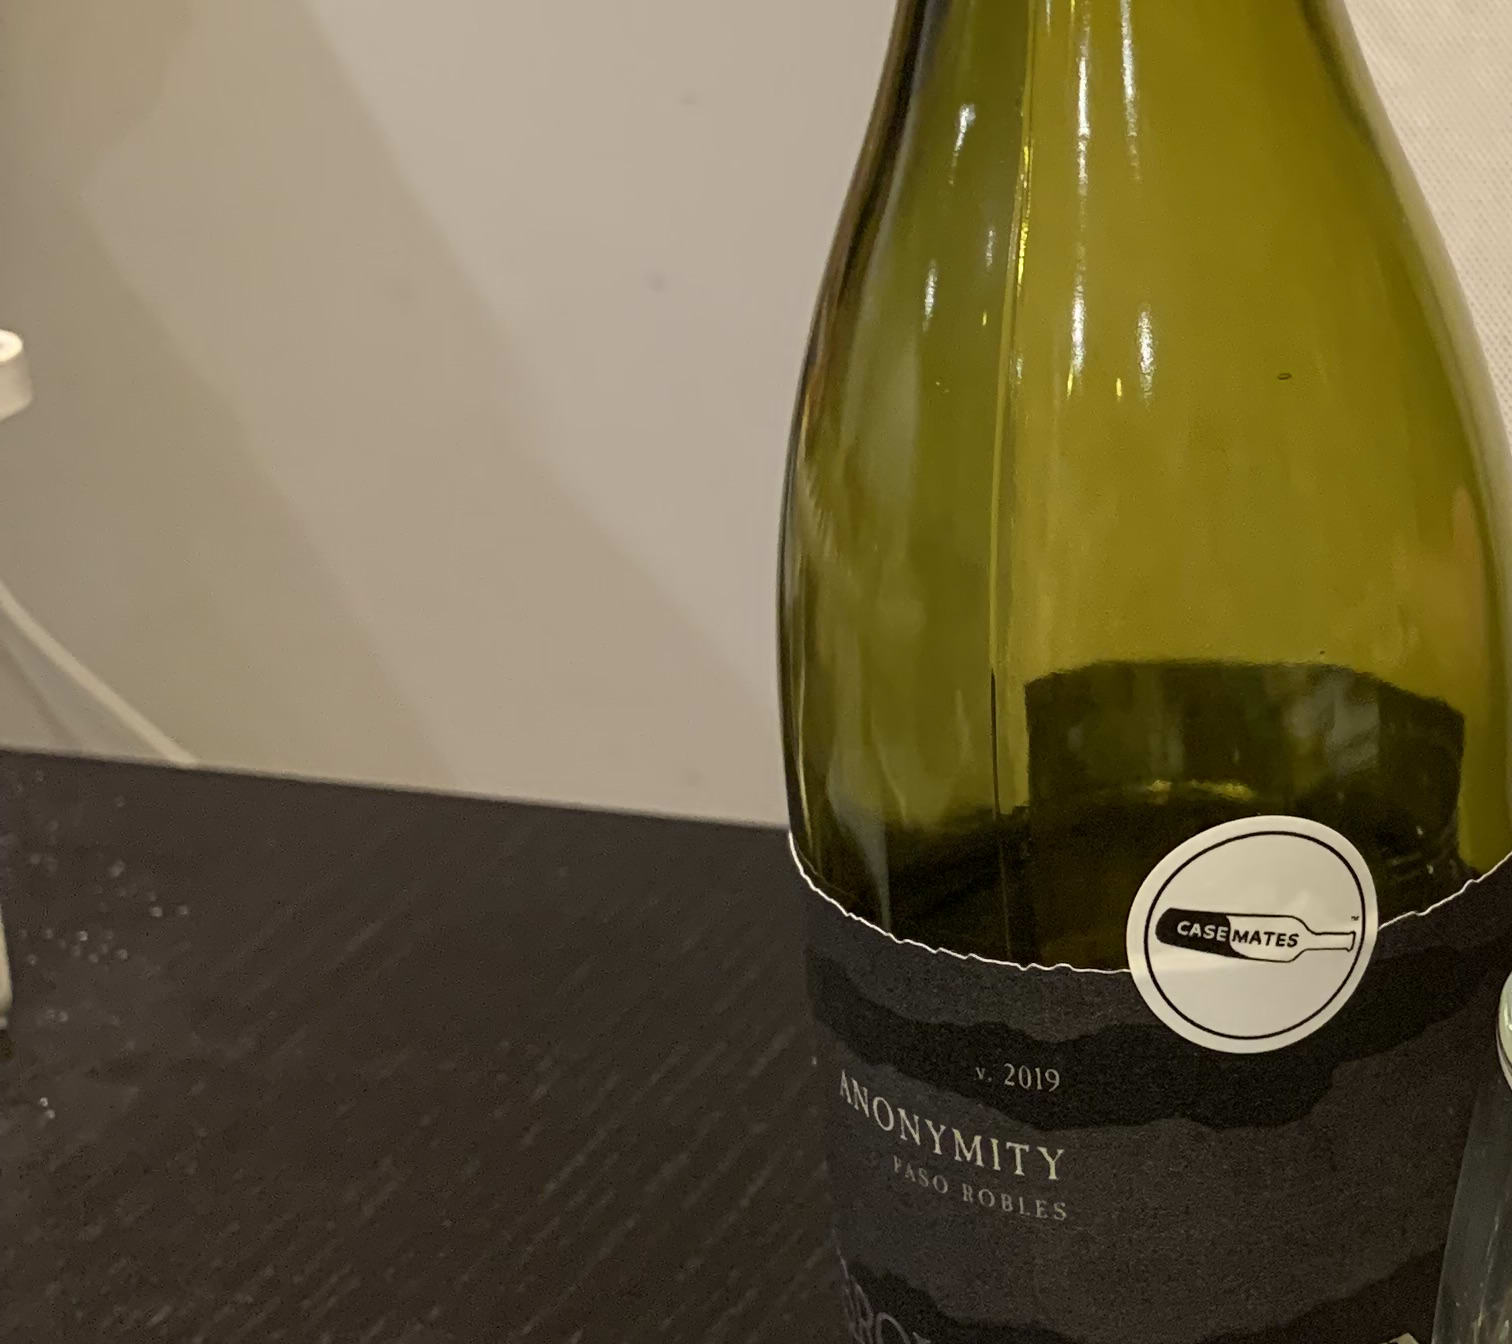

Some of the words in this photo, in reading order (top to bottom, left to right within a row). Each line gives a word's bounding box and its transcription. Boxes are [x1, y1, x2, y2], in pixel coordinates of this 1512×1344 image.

[1003, 1062, 1061, 1093] 2019
[839, 1068, 1065, 1181] ANONYMITY
[893, 1154, 949, 1194] PASO
[961, 1182, 1068, 1222] ROBLES
